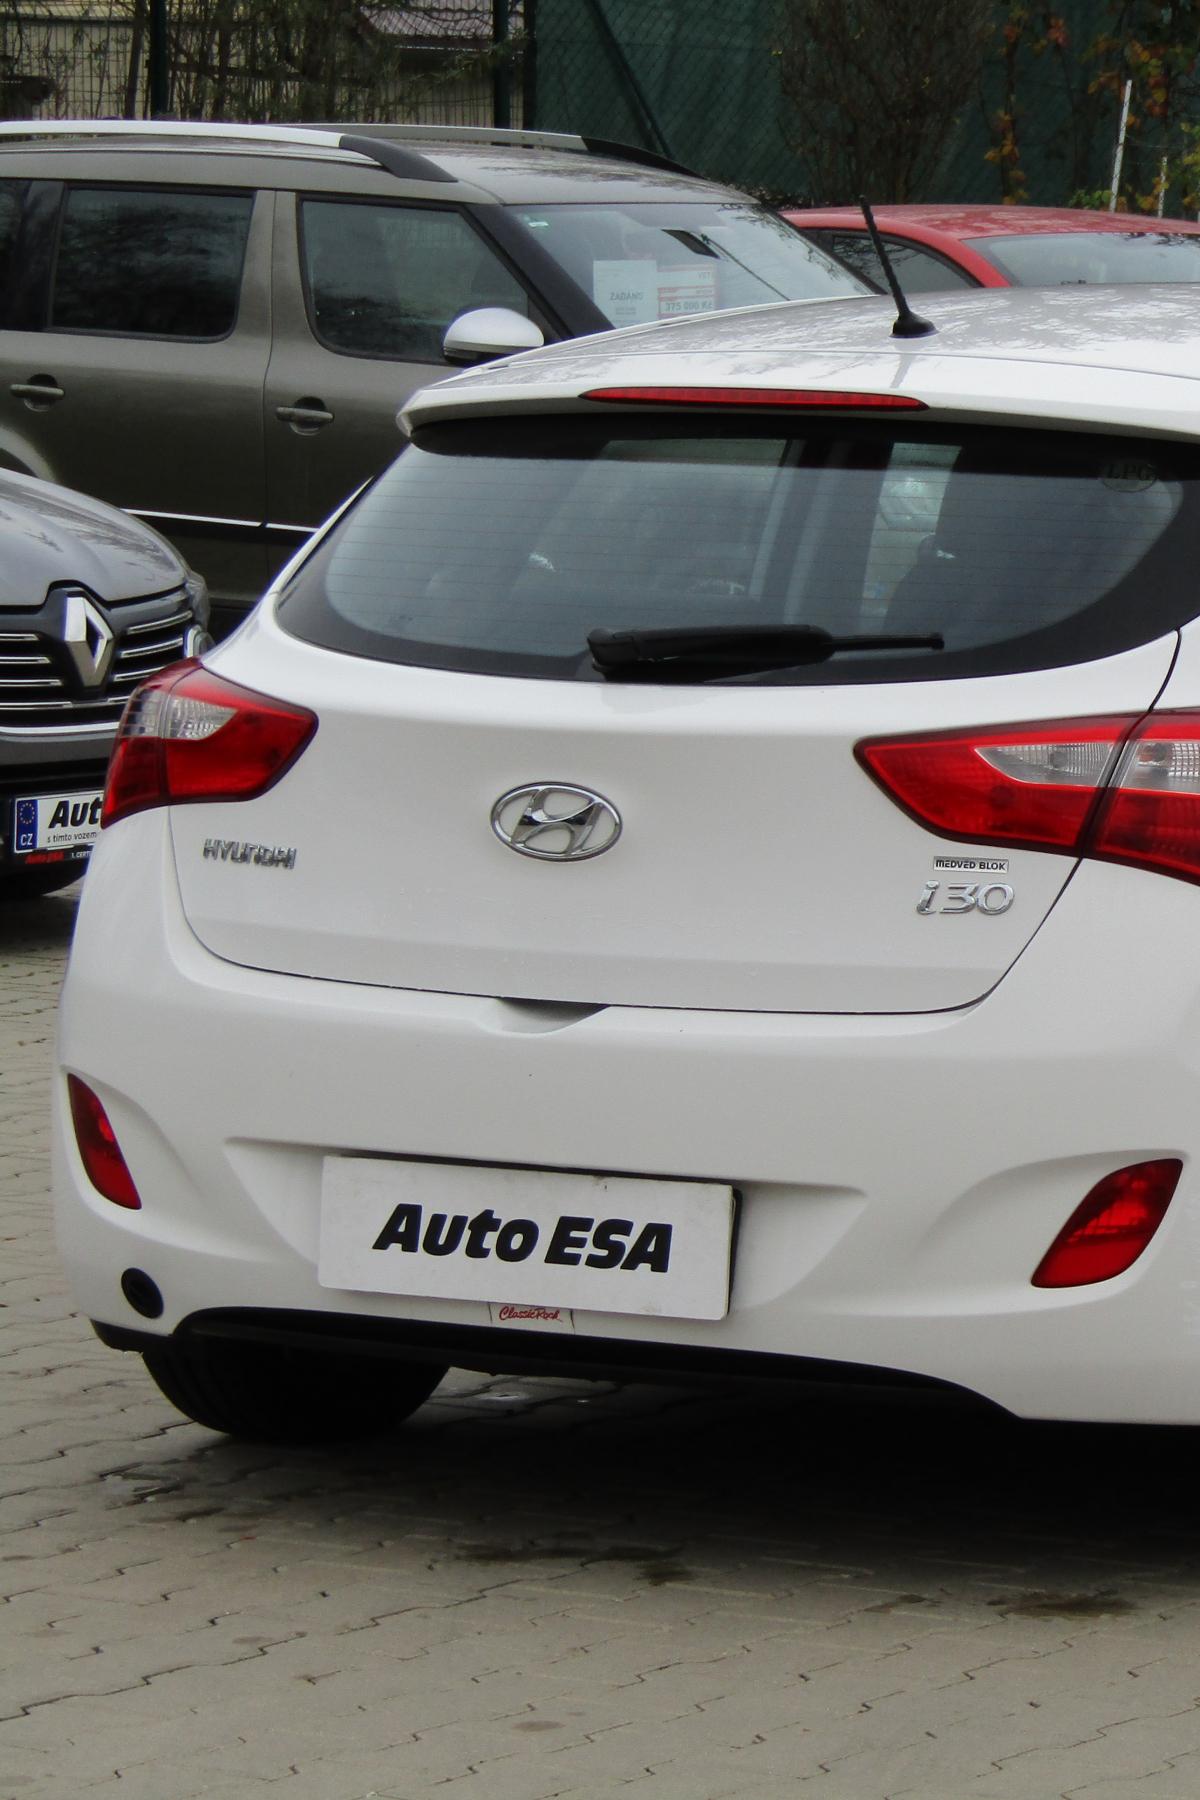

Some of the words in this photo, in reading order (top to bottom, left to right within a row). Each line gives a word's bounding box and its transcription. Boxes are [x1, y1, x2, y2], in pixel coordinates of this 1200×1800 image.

[20, 833, 33, 846] CZ
[203, 838, 297, 870] HYUNDAI
[978, 861, 1006, 870] BLOK
[917, 881, 1015, 916] i30
[372, 1203, 540, 1263] Auto
[544, 1216, 673, 1274] ESA
